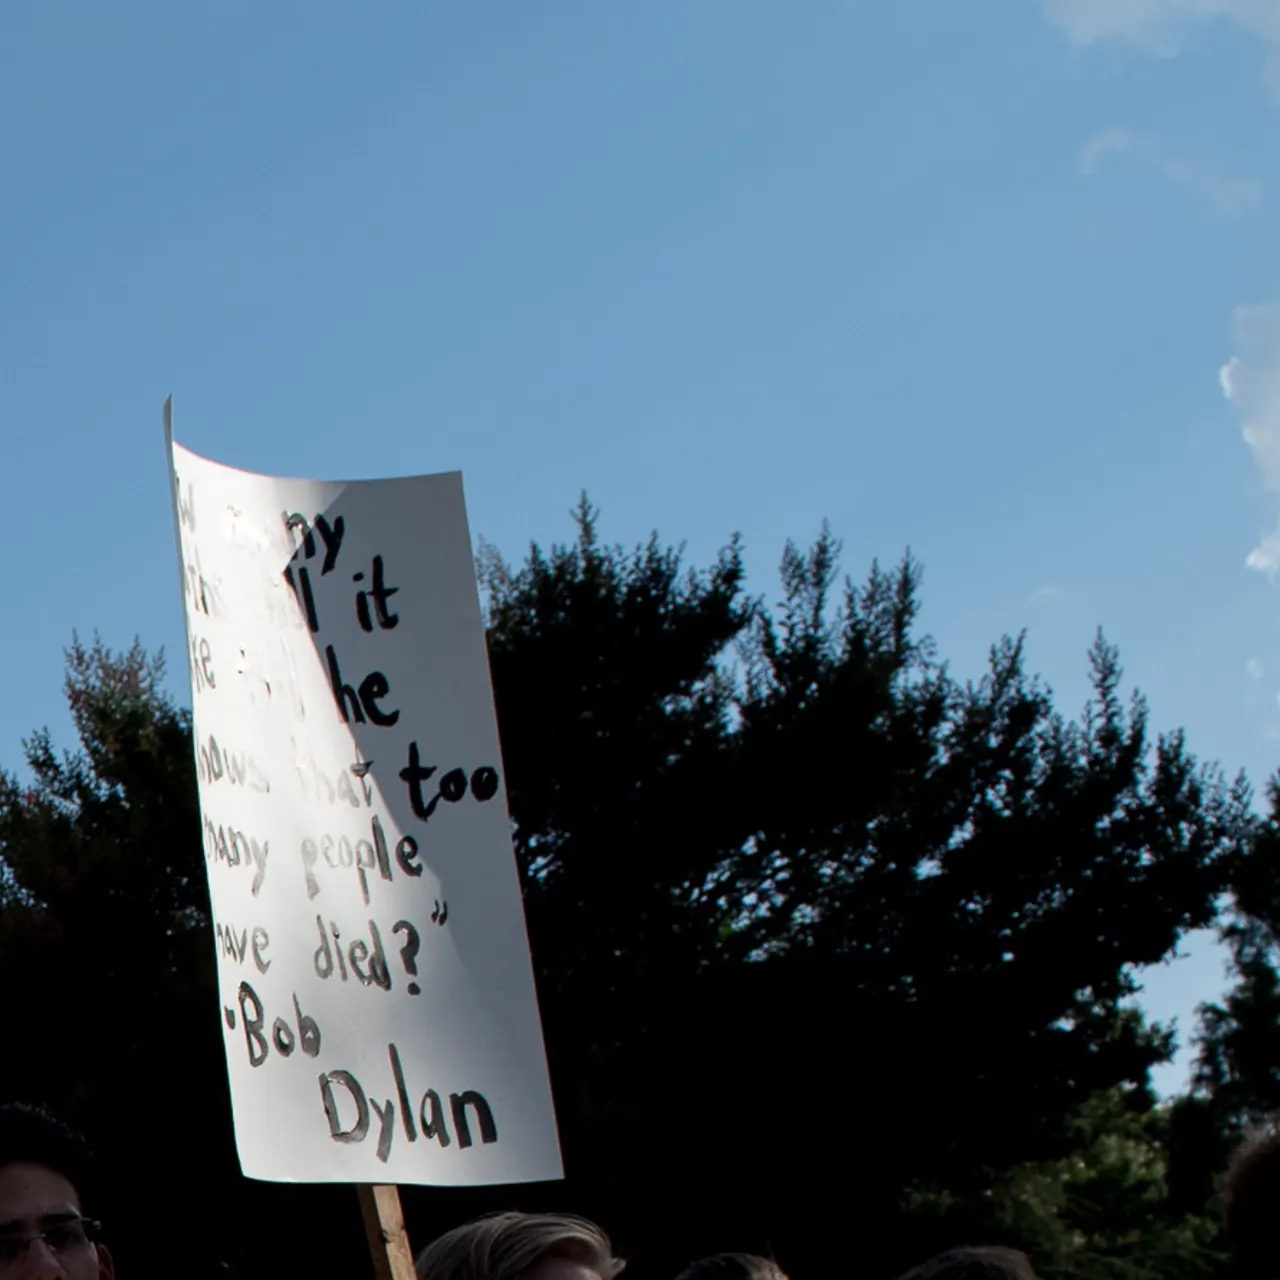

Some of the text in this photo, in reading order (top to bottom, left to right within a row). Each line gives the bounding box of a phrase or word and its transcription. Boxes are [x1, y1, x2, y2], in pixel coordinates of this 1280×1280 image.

[352, 554, 400, 633] it
[325, 644, 401, 727] he
[398, 740, 500, 822] too
[300, 813, 423, 906] people
[318, 1043, 498, 1164] Dylan
